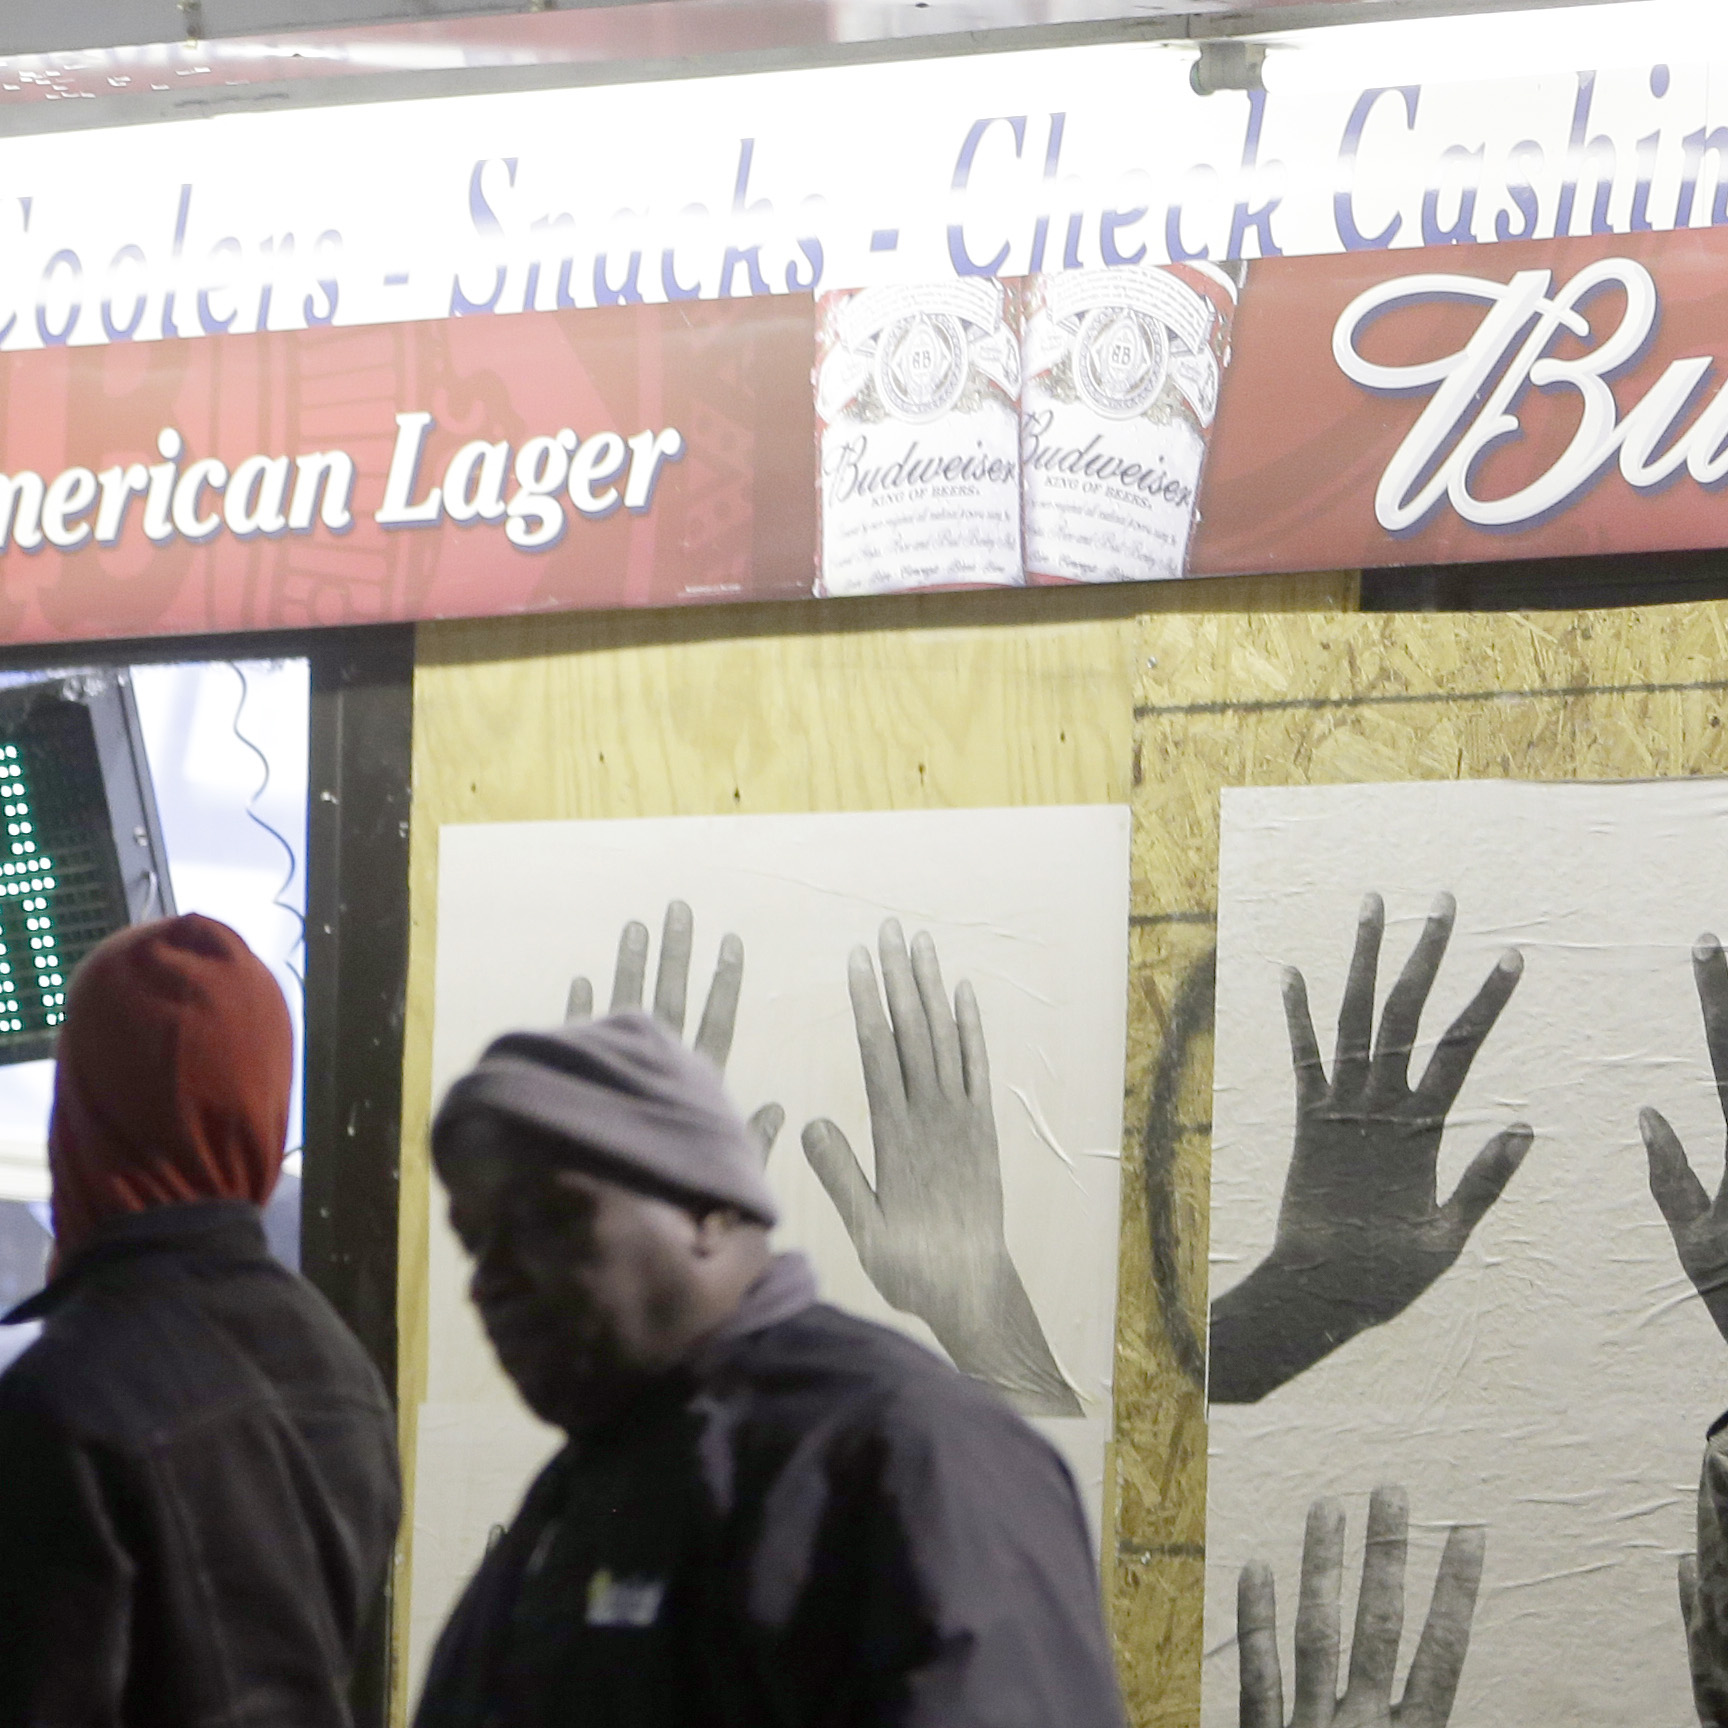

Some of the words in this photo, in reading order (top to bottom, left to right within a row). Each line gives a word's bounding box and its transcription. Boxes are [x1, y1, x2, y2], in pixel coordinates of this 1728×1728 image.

[448, 138, 824, 317] Snacks
[947, 90, 1286, 277] Check
[375, 410, 683, 547] Lager
[823, 436, 1018, 508] Budweiser
[1021, 410, 1194, 507] Budweiser
